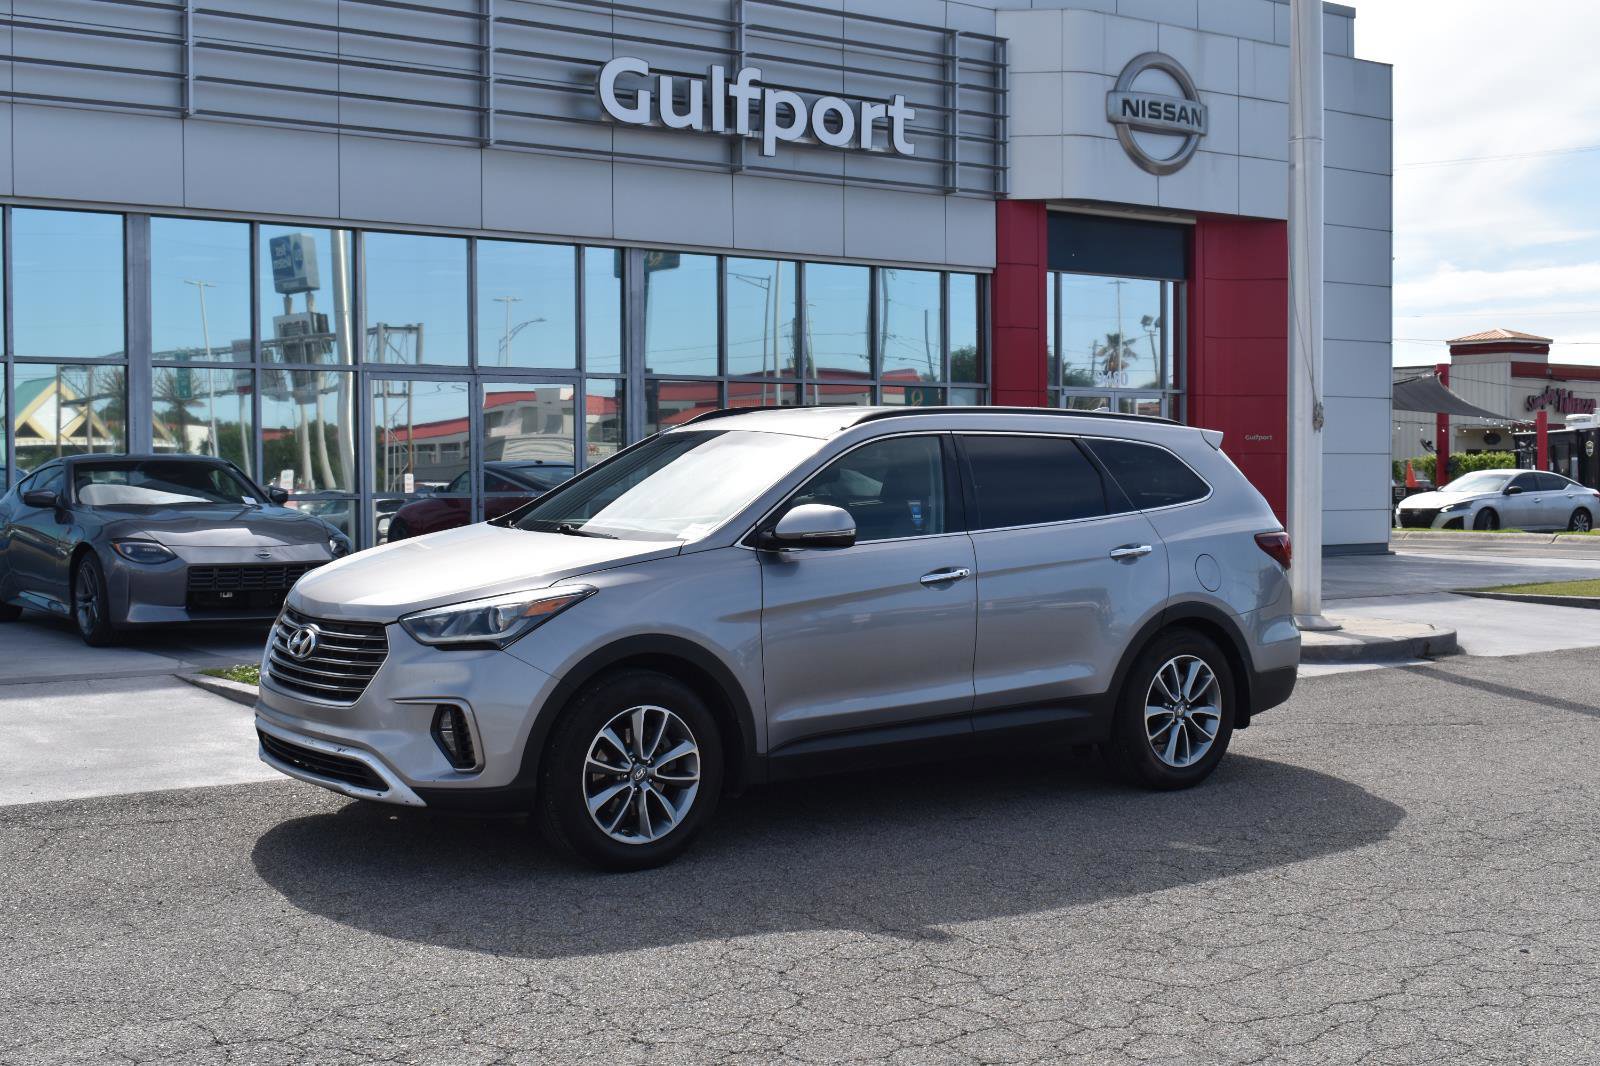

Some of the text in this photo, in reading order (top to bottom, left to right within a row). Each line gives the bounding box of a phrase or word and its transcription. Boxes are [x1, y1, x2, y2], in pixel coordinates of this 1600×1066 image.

[599, 56, 915, 157] Gulfport
[1121, 97, 1202, 128] NISSAN
[1244, 434, 1273, 442] Gulfport
